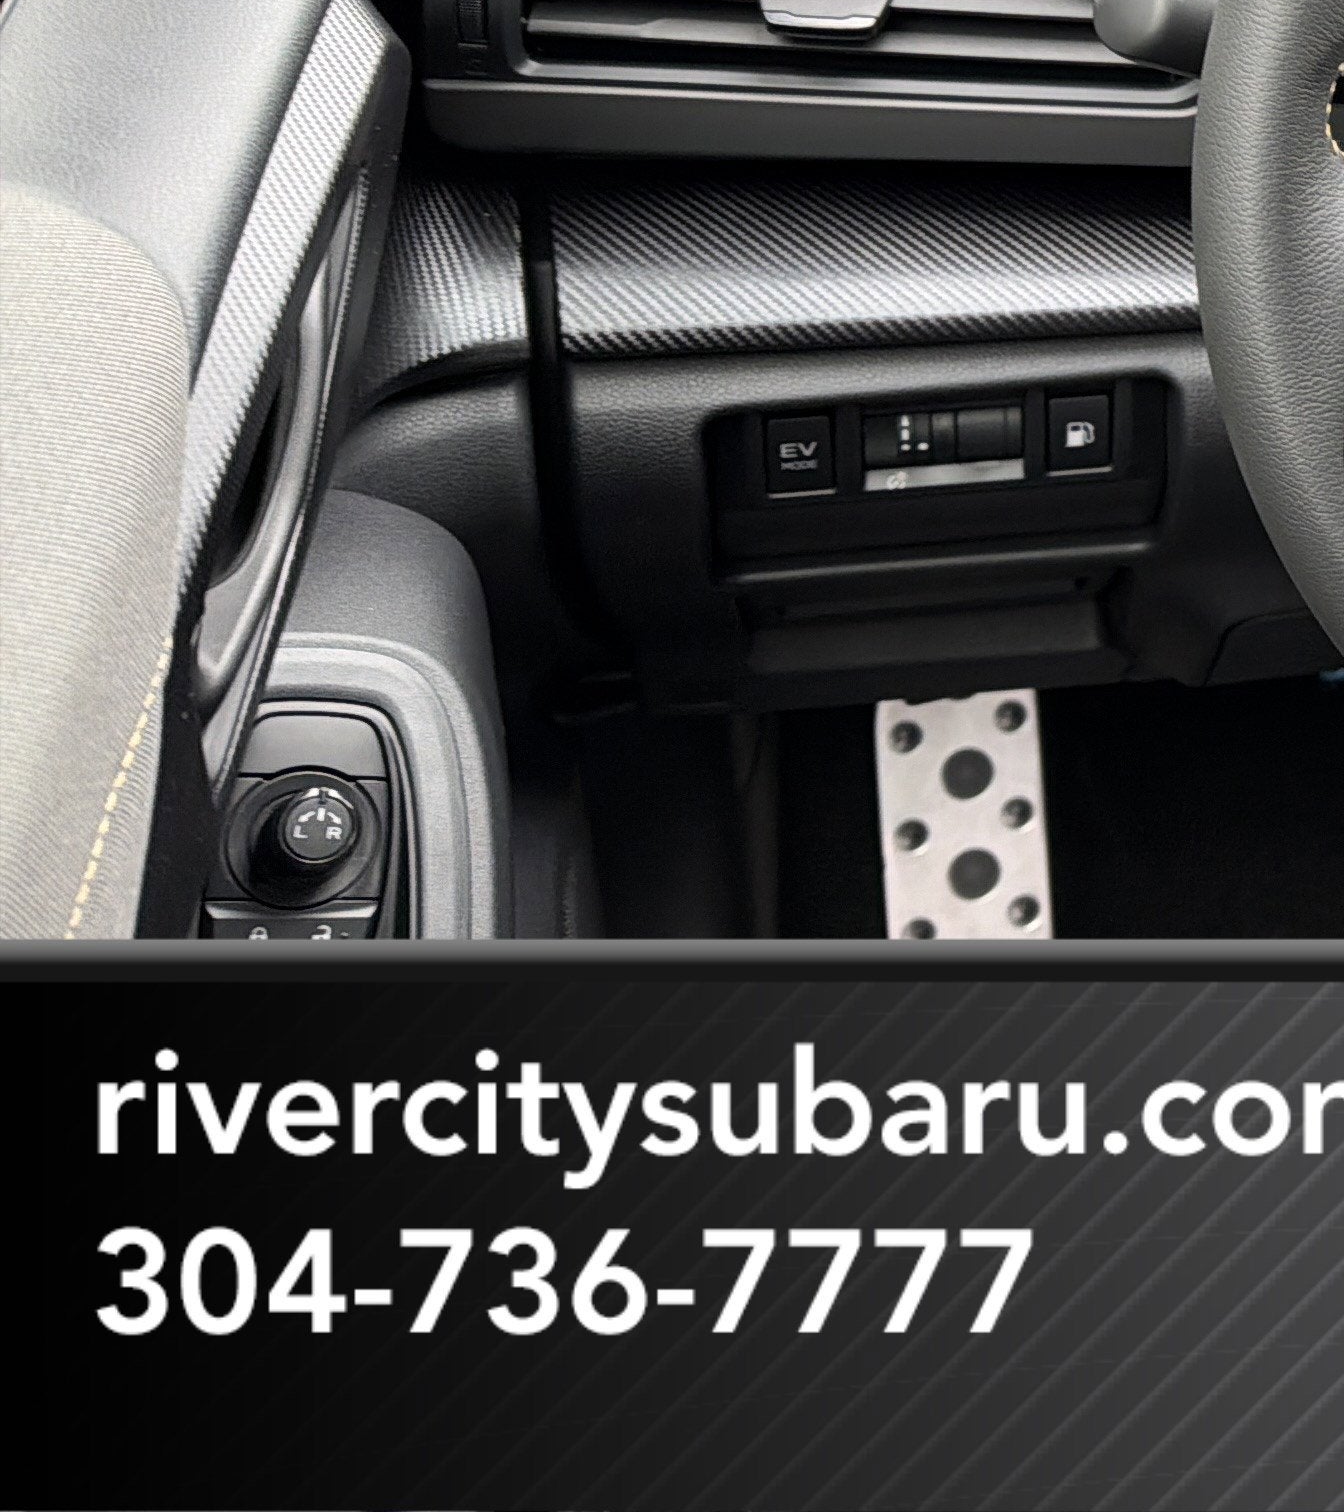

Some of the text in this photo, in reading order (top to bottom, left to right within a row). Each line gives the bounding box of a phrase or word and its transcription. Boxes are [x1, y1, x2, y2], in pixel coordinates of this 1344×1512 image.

[780, 441, 817, 458] EV
[294, 826, 342, 839] L R
